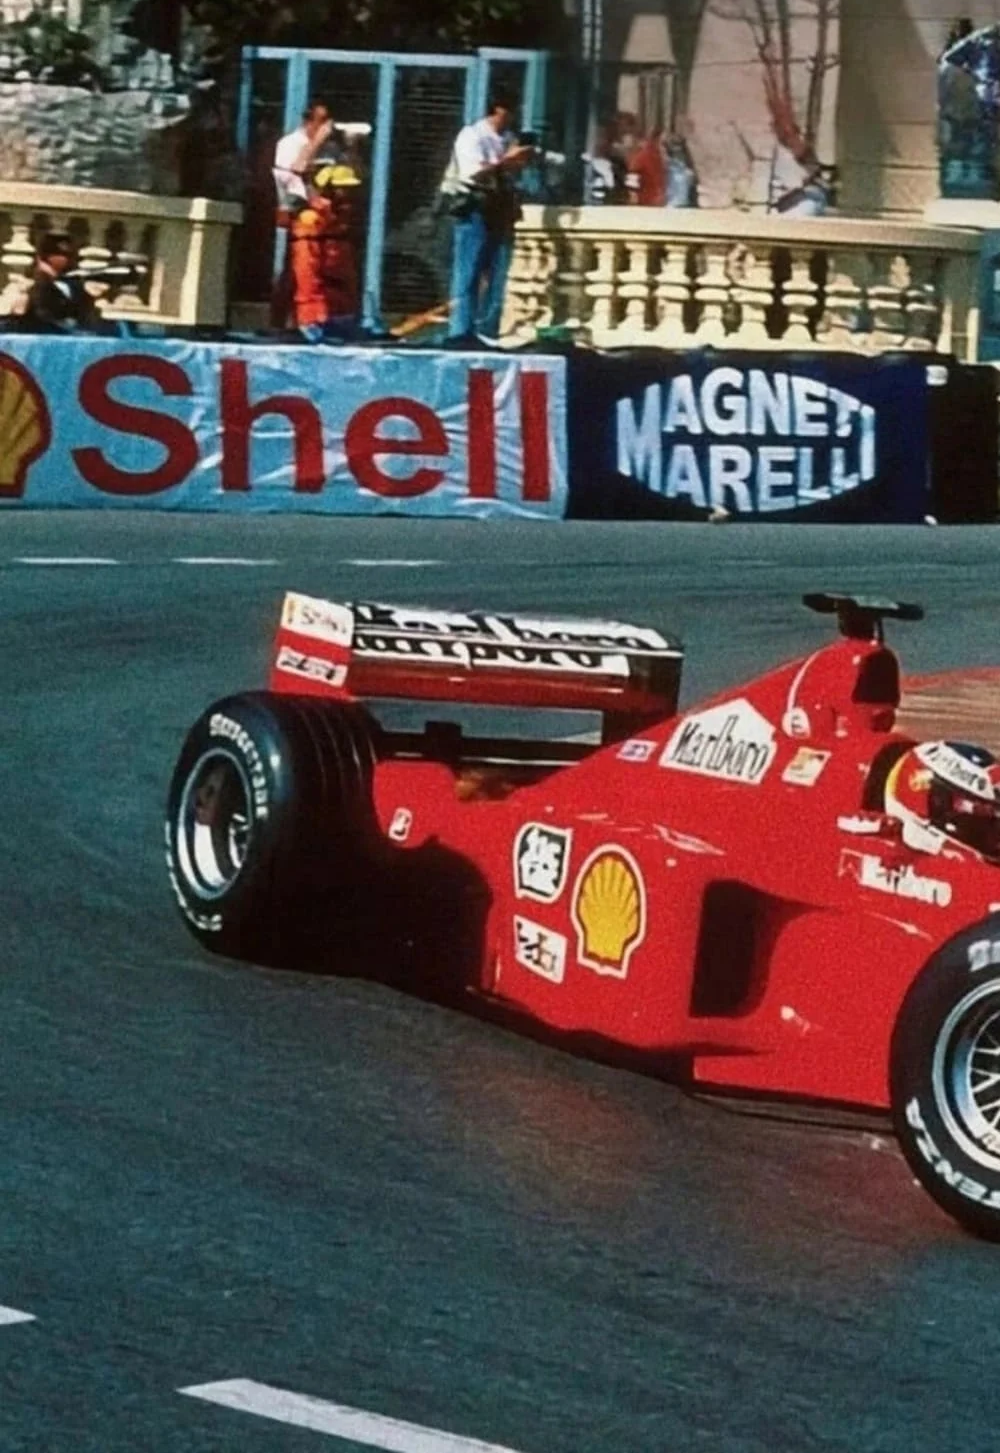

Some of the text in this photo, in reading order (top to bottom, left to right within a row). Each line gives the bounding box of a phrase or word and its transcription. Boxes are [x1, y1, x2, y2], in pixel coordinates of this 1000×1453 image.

[72, 356, 551, 502] Shell
[616, 367, 875, 493] MAGNETI
[616, 398, 875, 512] MARELLI
[670, 714, 769, 780] Marlboro
